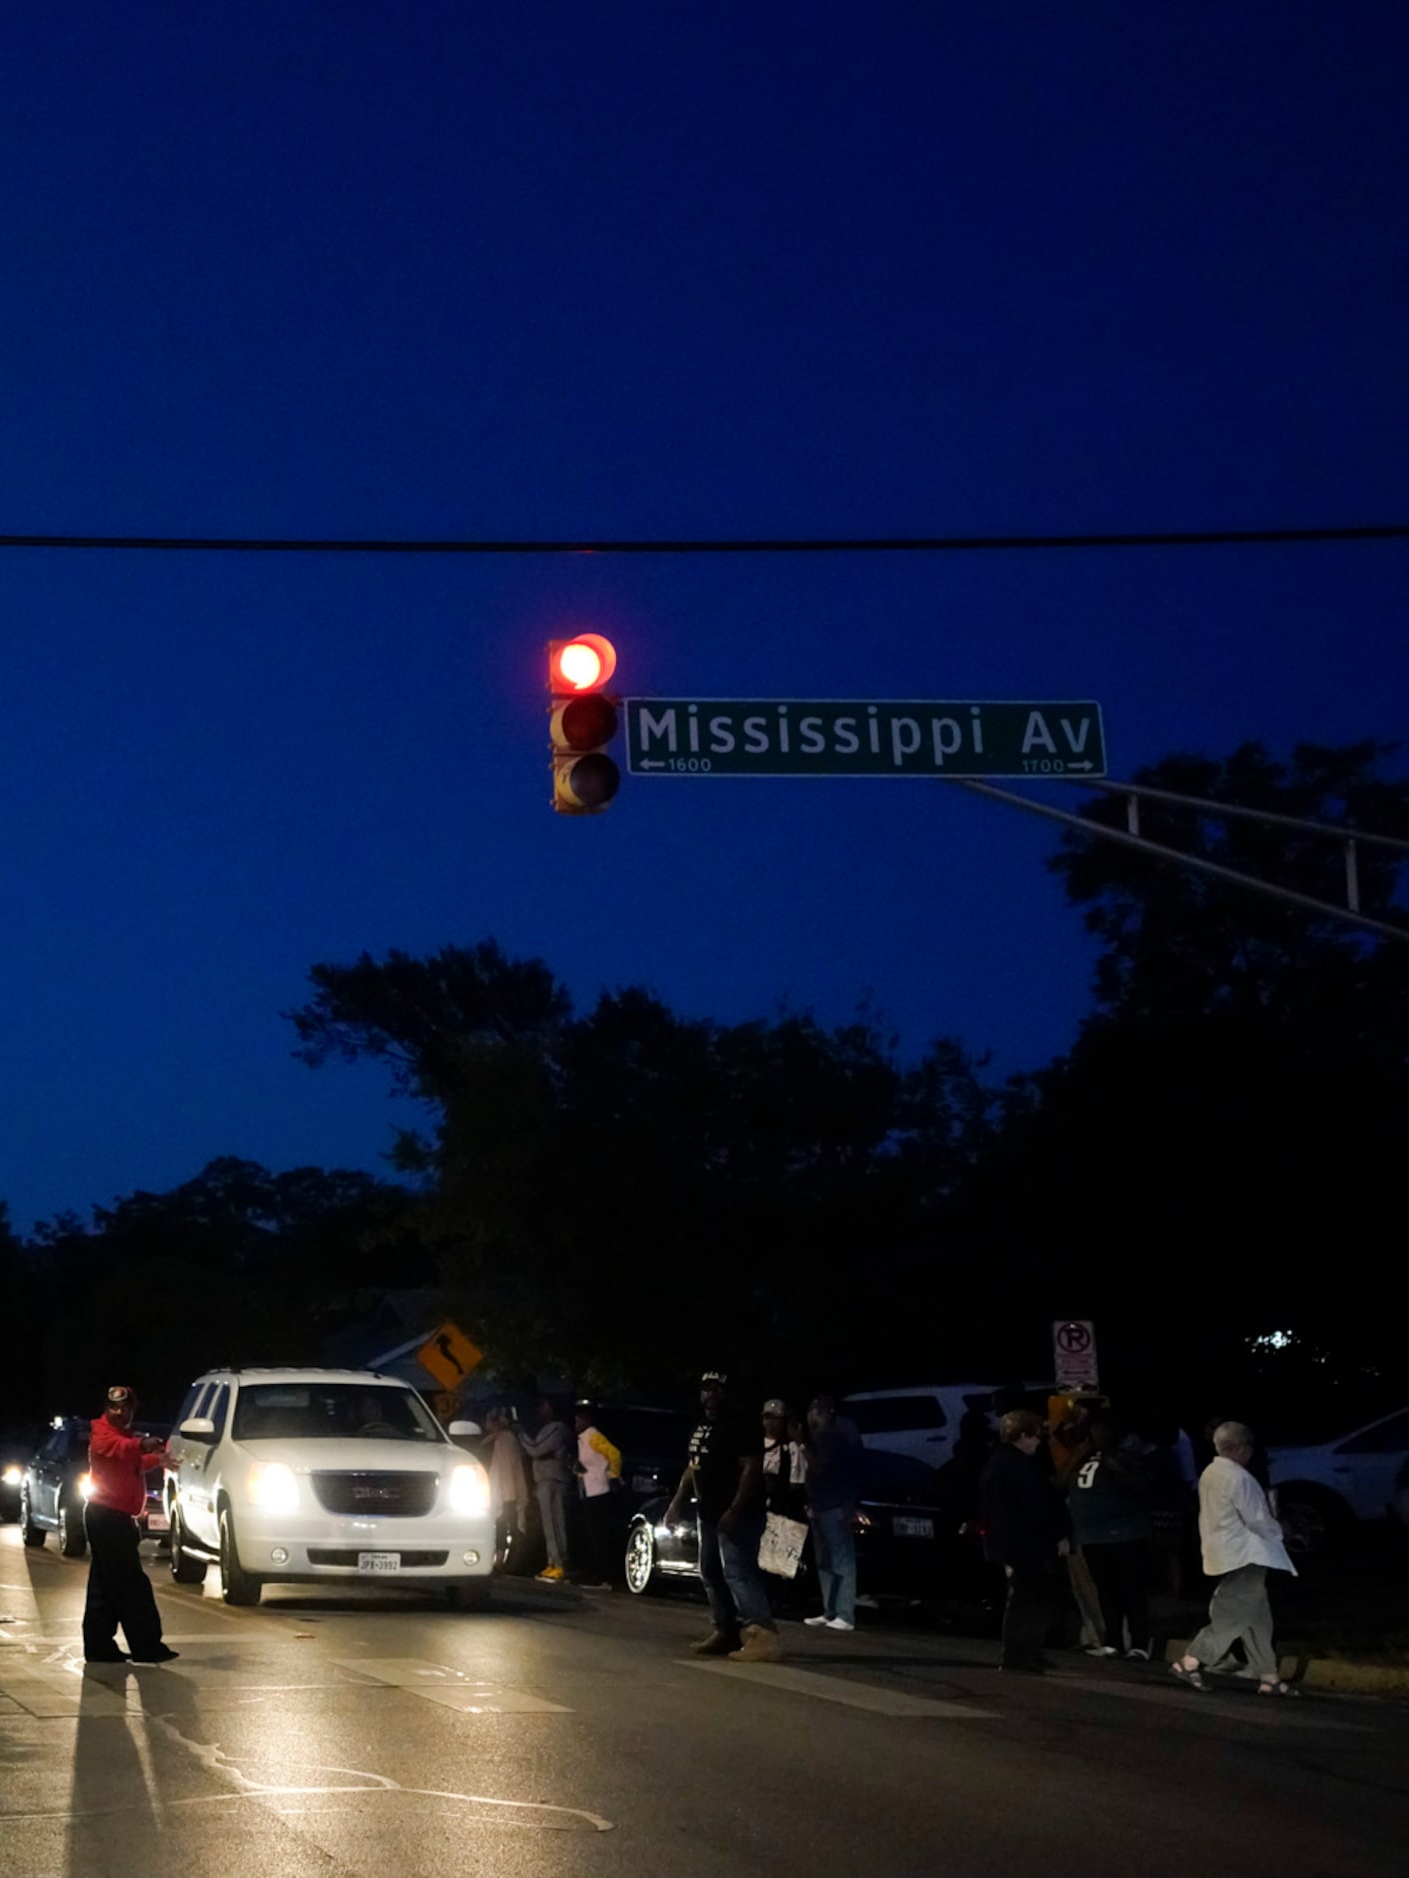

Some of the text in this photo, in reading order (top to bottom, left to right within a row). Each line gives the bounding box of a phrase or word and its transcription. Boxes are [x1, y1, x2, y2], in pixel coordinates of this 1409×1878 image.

[639, 703, 1091, 767] Mississippi Av
[668, 757, 712, 772] 1600
[1022, 758, 1065, 773] 1700
[1077, 1460, 1101, 1489] 9
